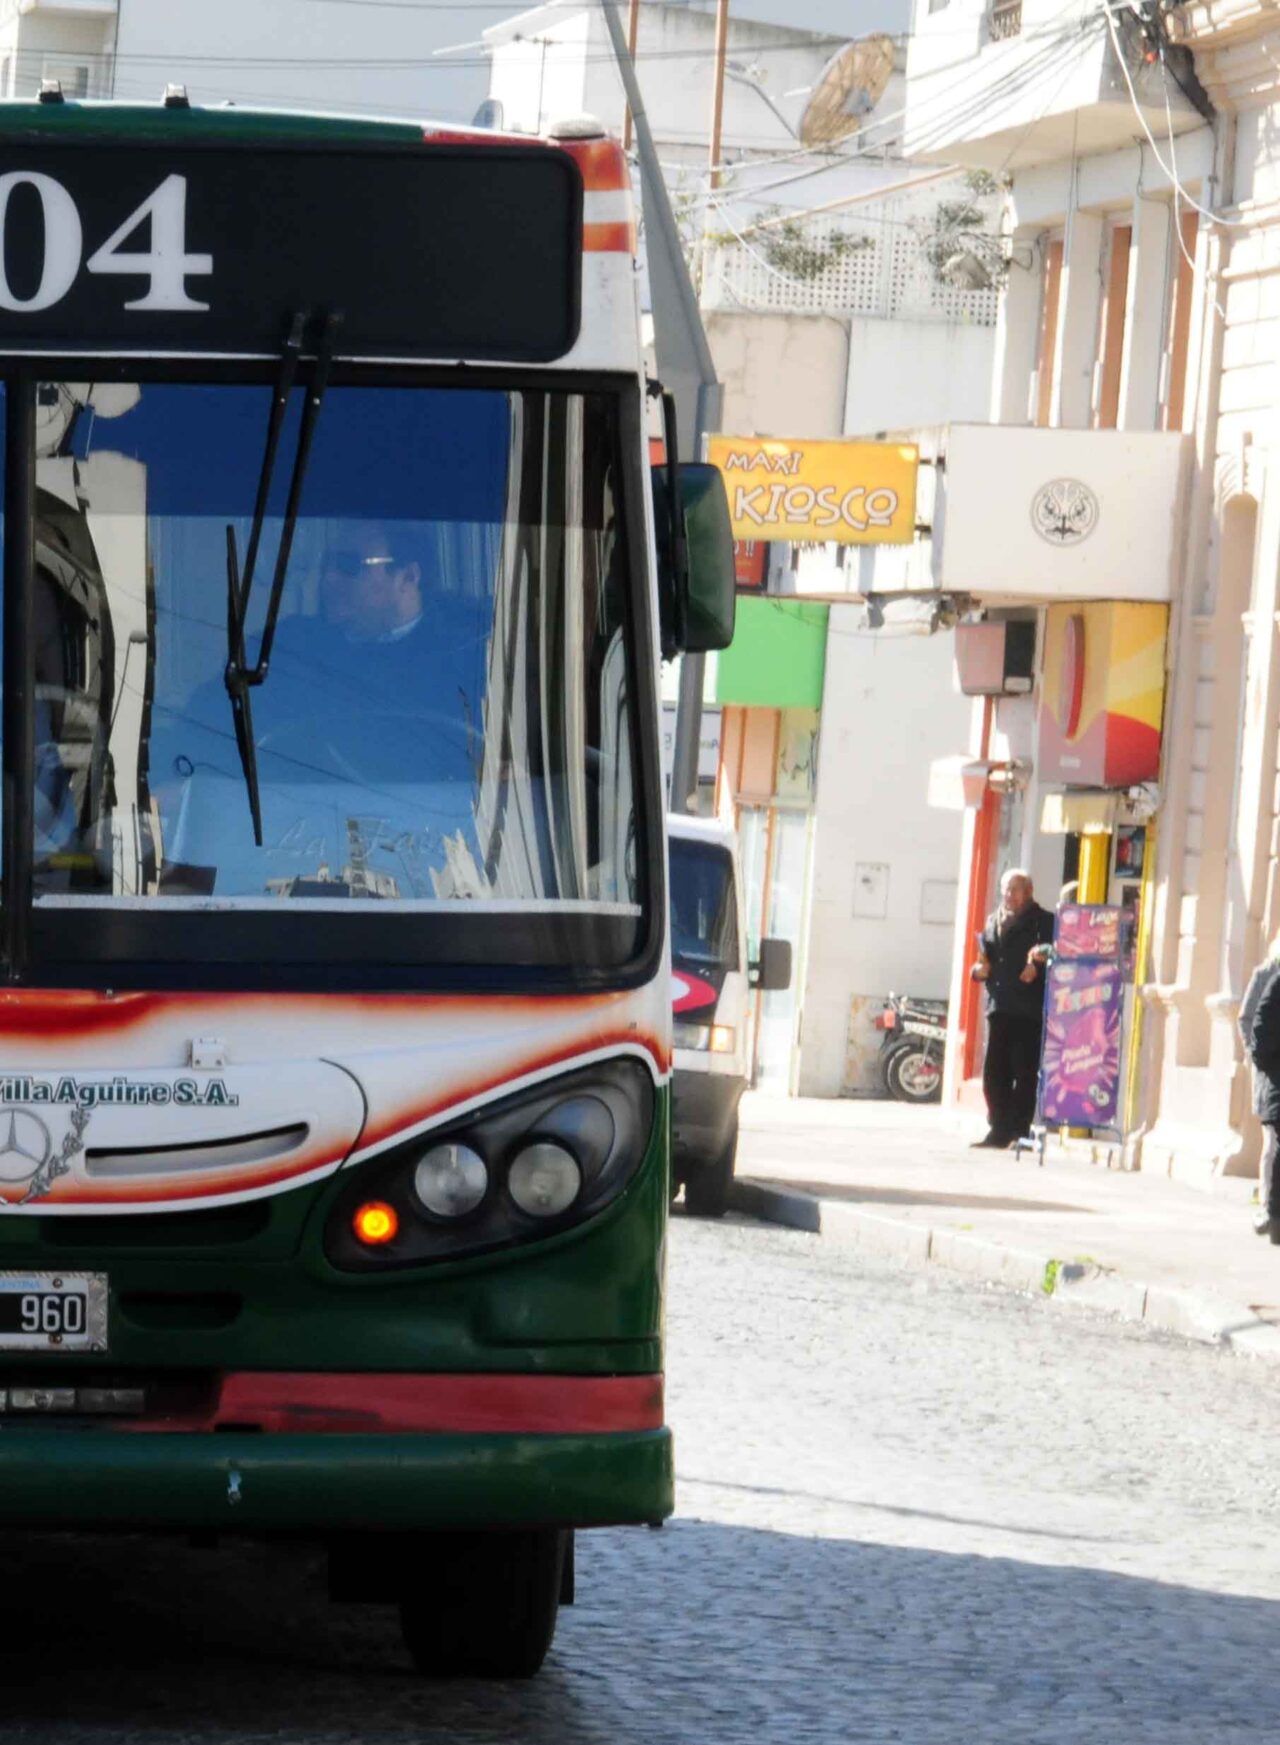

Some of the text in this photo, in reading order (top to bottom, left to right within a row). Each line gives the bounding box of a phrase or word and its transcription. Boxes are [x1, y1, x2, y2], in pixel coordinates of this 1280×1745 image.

[725, 451, 803, 475] MAXI
[734, 483, 899, 531] KIOSCO
[54, 1076, 171, 1109] Aguirre
[173, 1078, 240, 1107] S.A.
[20, 1295, 82, 1332] 960
